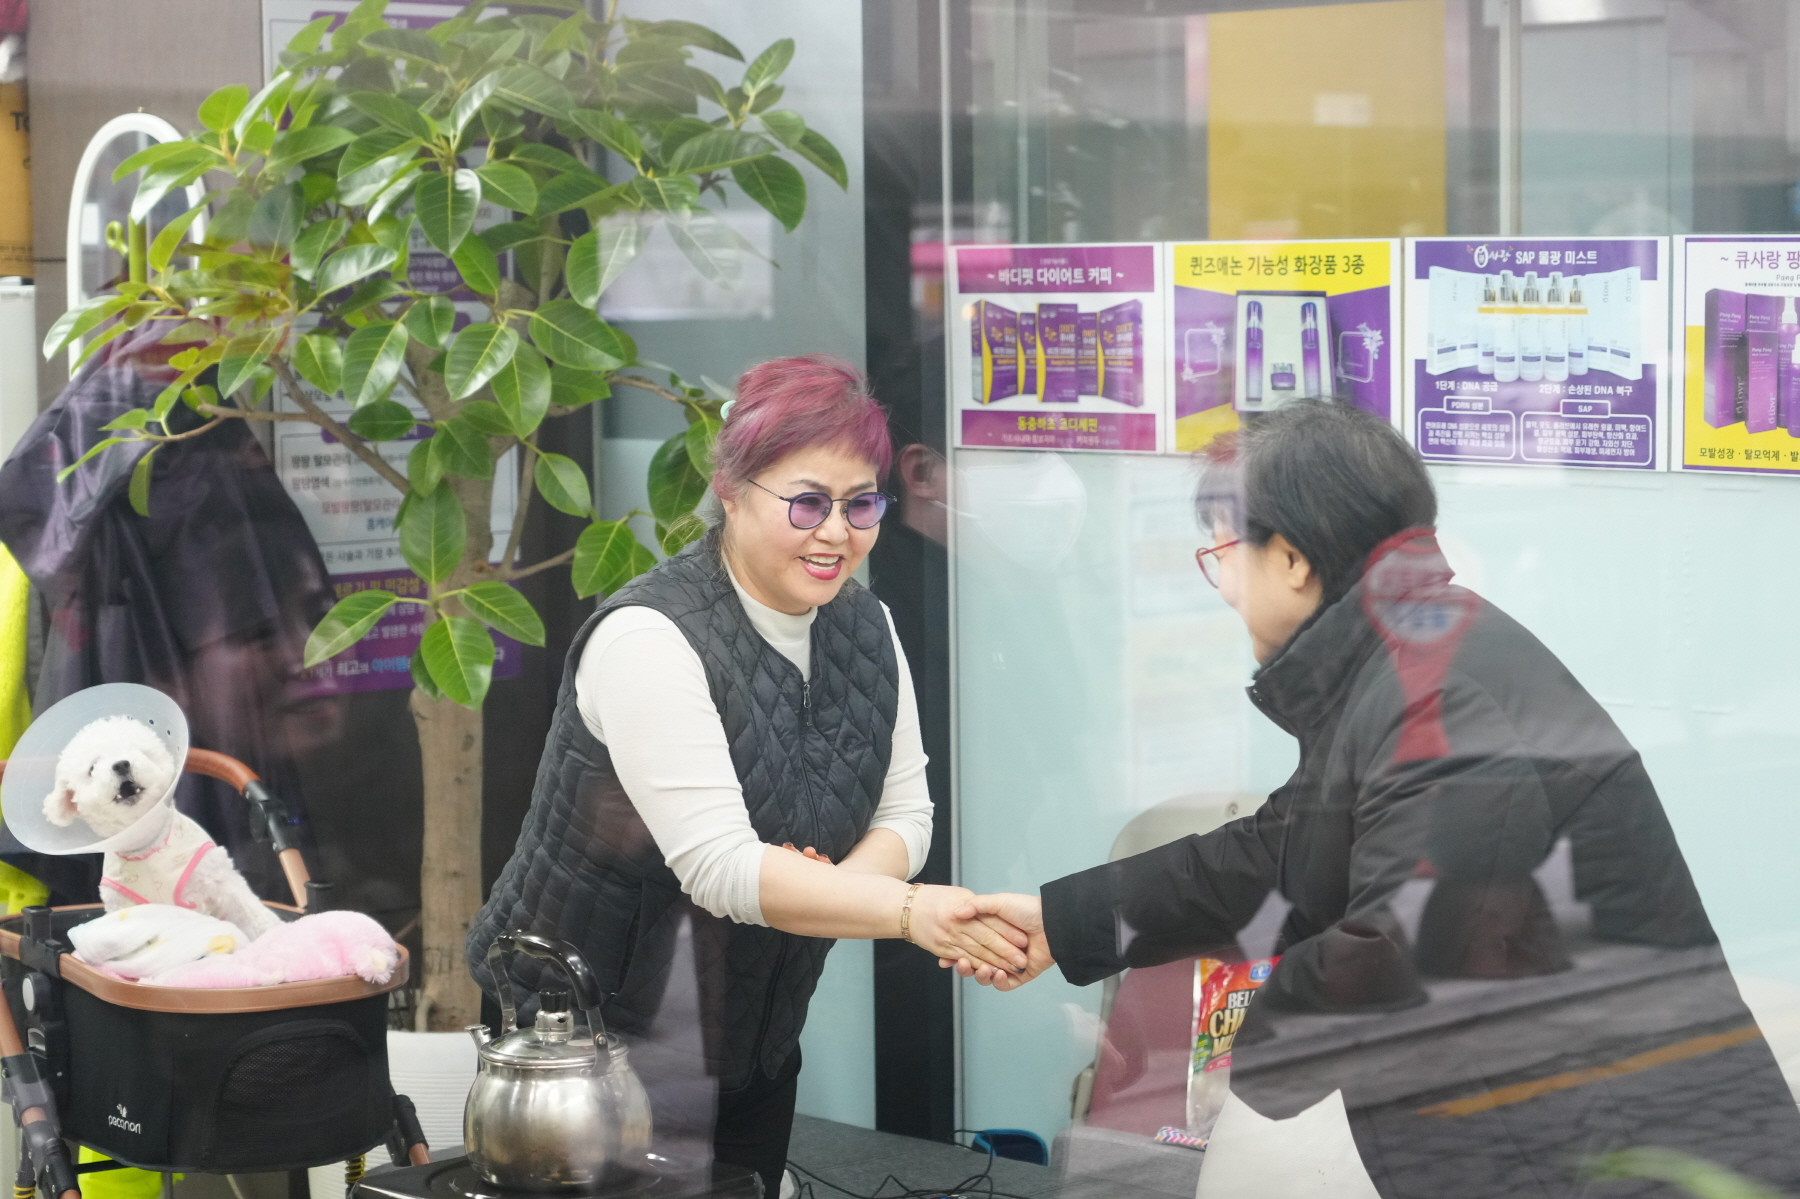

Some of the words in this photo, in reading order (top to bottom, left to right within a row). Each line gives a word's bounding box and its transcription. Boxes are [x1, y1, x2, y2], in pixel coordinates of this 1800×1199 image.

[1515, 250, 1535, 264] SAP
[1539, 250, 1561, 265] 물광
[1565, 250, 1597, 264] 미스트
[1735, 250, 1781, 270] 큐사랑
[1248, 255, 1289, 276] 기능성
[1294, 255, 1337, 275] 화장품
[1342, 255, 1365, 275] 3종
[998, 268, 1034, 286] 바디핏
[1036, 267, 1085, 285] 다이어트
[1088, 267, 1112, 285] 커피
[1776, 274, 1794, 282] Pang
[1435, 381, 1455, 391] 1단계
[1462, 382, 1480, 391] DNA
[1482, 382, 1498, 392] 공급
[1539, 384, 1561, 394] 2단계
[1568, 385, 1592, 396] 손상된
[1594, 386, 1613, 395] DNA
[1578, 405, 1593, 413] SAP
[1017, 416, 1056, 431] 동충하초
[1699, 448, 1735, 459] 모발성장
[1744, 449, 1780, 462] 탈모억제
[1790, 450, 1800, 462] 발
